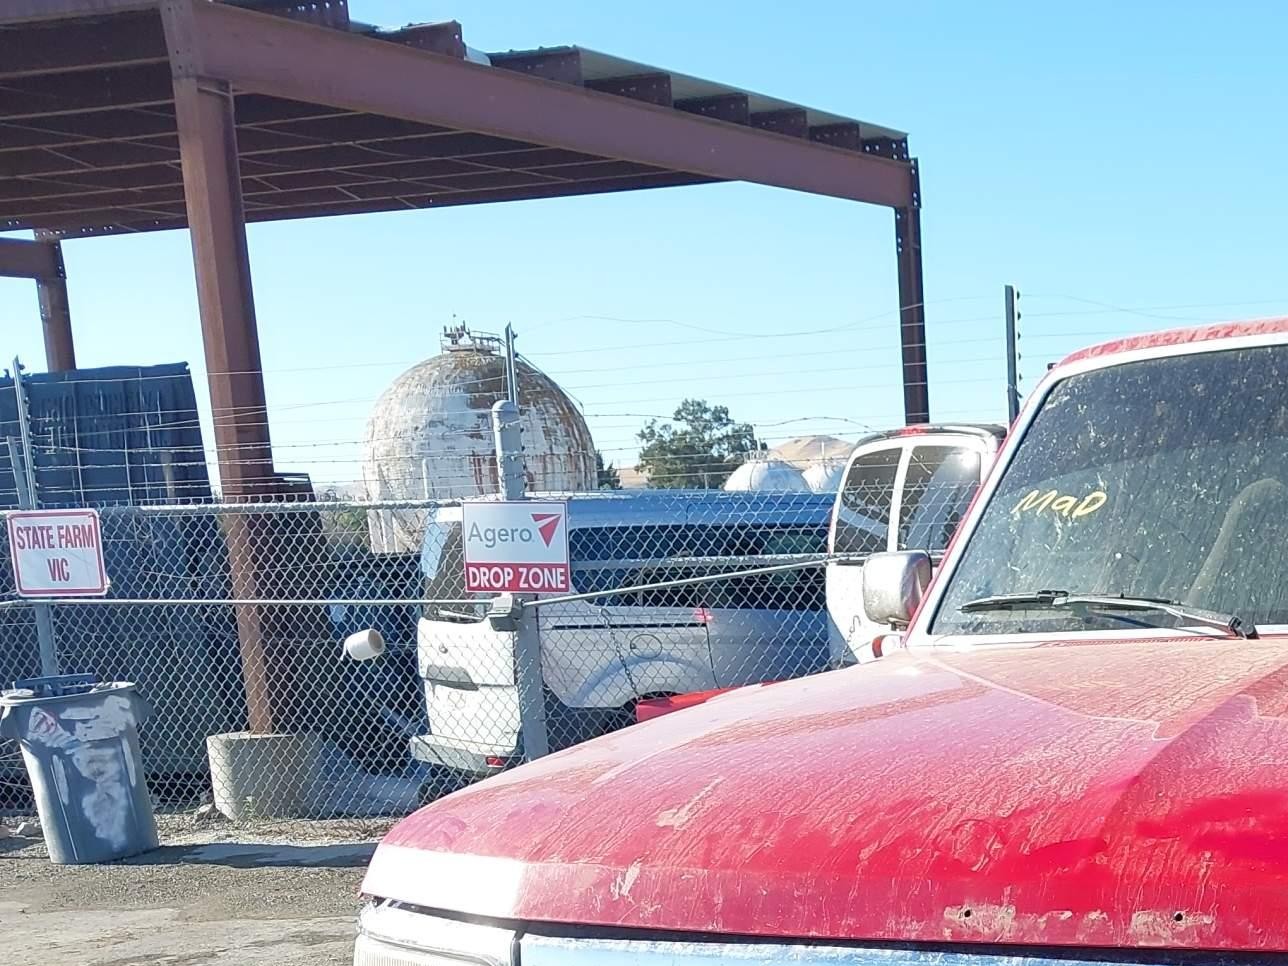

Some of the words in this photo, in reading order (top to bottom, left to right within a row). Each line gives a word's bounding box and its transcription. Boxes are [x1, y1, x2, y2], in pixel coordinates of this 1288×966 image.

[16, 525, 55, 550] STATE
[56, 524, 95, 549] FARM
[468, 521, 532, 549] Agero
[47, 557, 70, 582] VIC
[468, 566, 514, 588] DROP
[518, 567, 566, 589] ZONE
